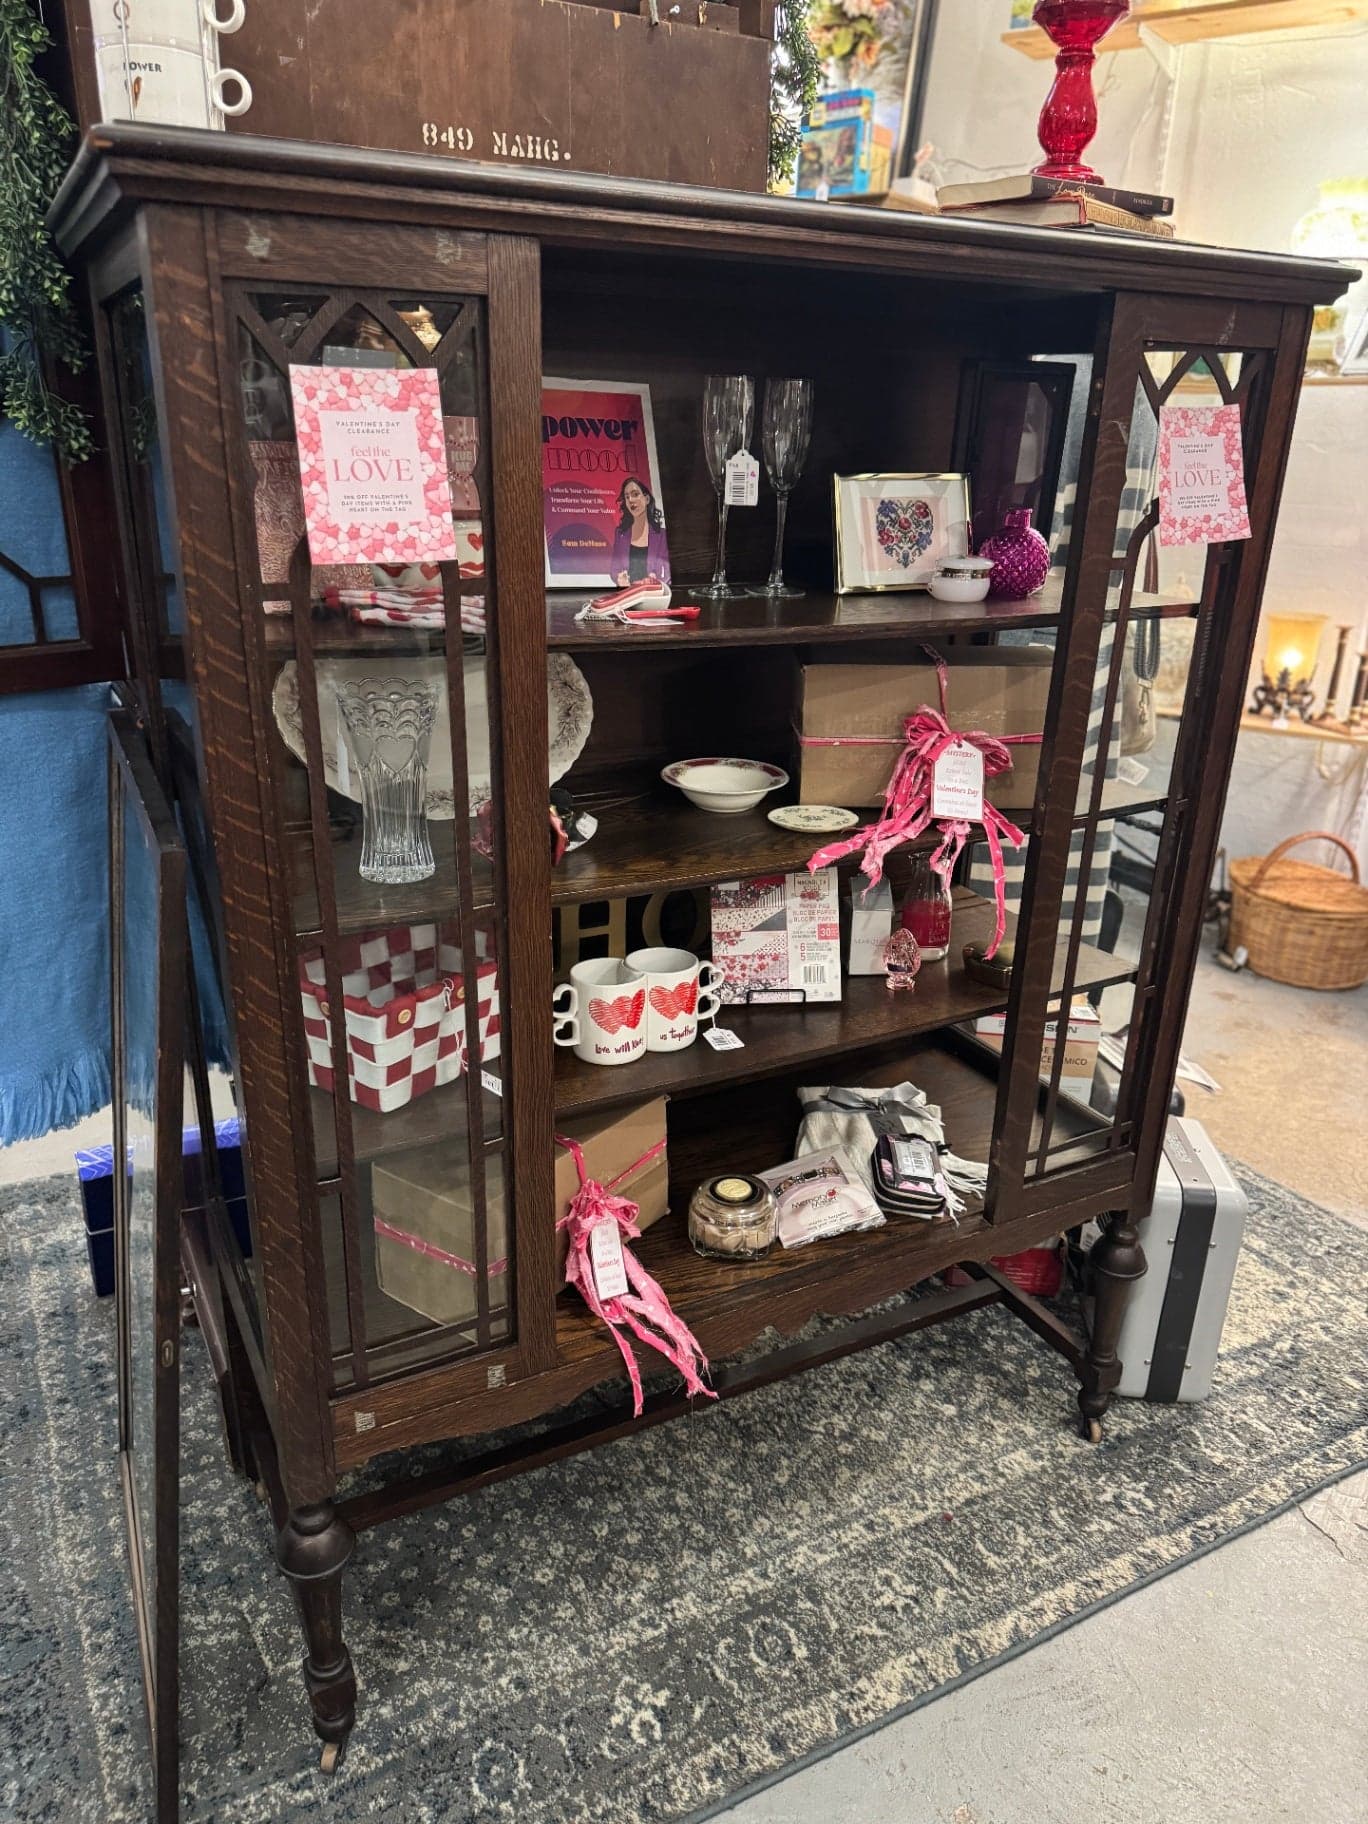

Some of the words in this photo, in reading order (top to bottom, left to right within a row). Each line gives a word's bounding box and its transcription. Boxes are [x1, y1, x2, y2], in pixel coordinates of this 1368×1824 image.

[422, 122, 474, 151] 849
[542, 416, 639, 443] power
[332, 459, 414, 482] LOVE
[547, 444, 639, 473] mood
[1175, 469, 1222, 488] LOVE
[615, 1039, 631, 1054] will
